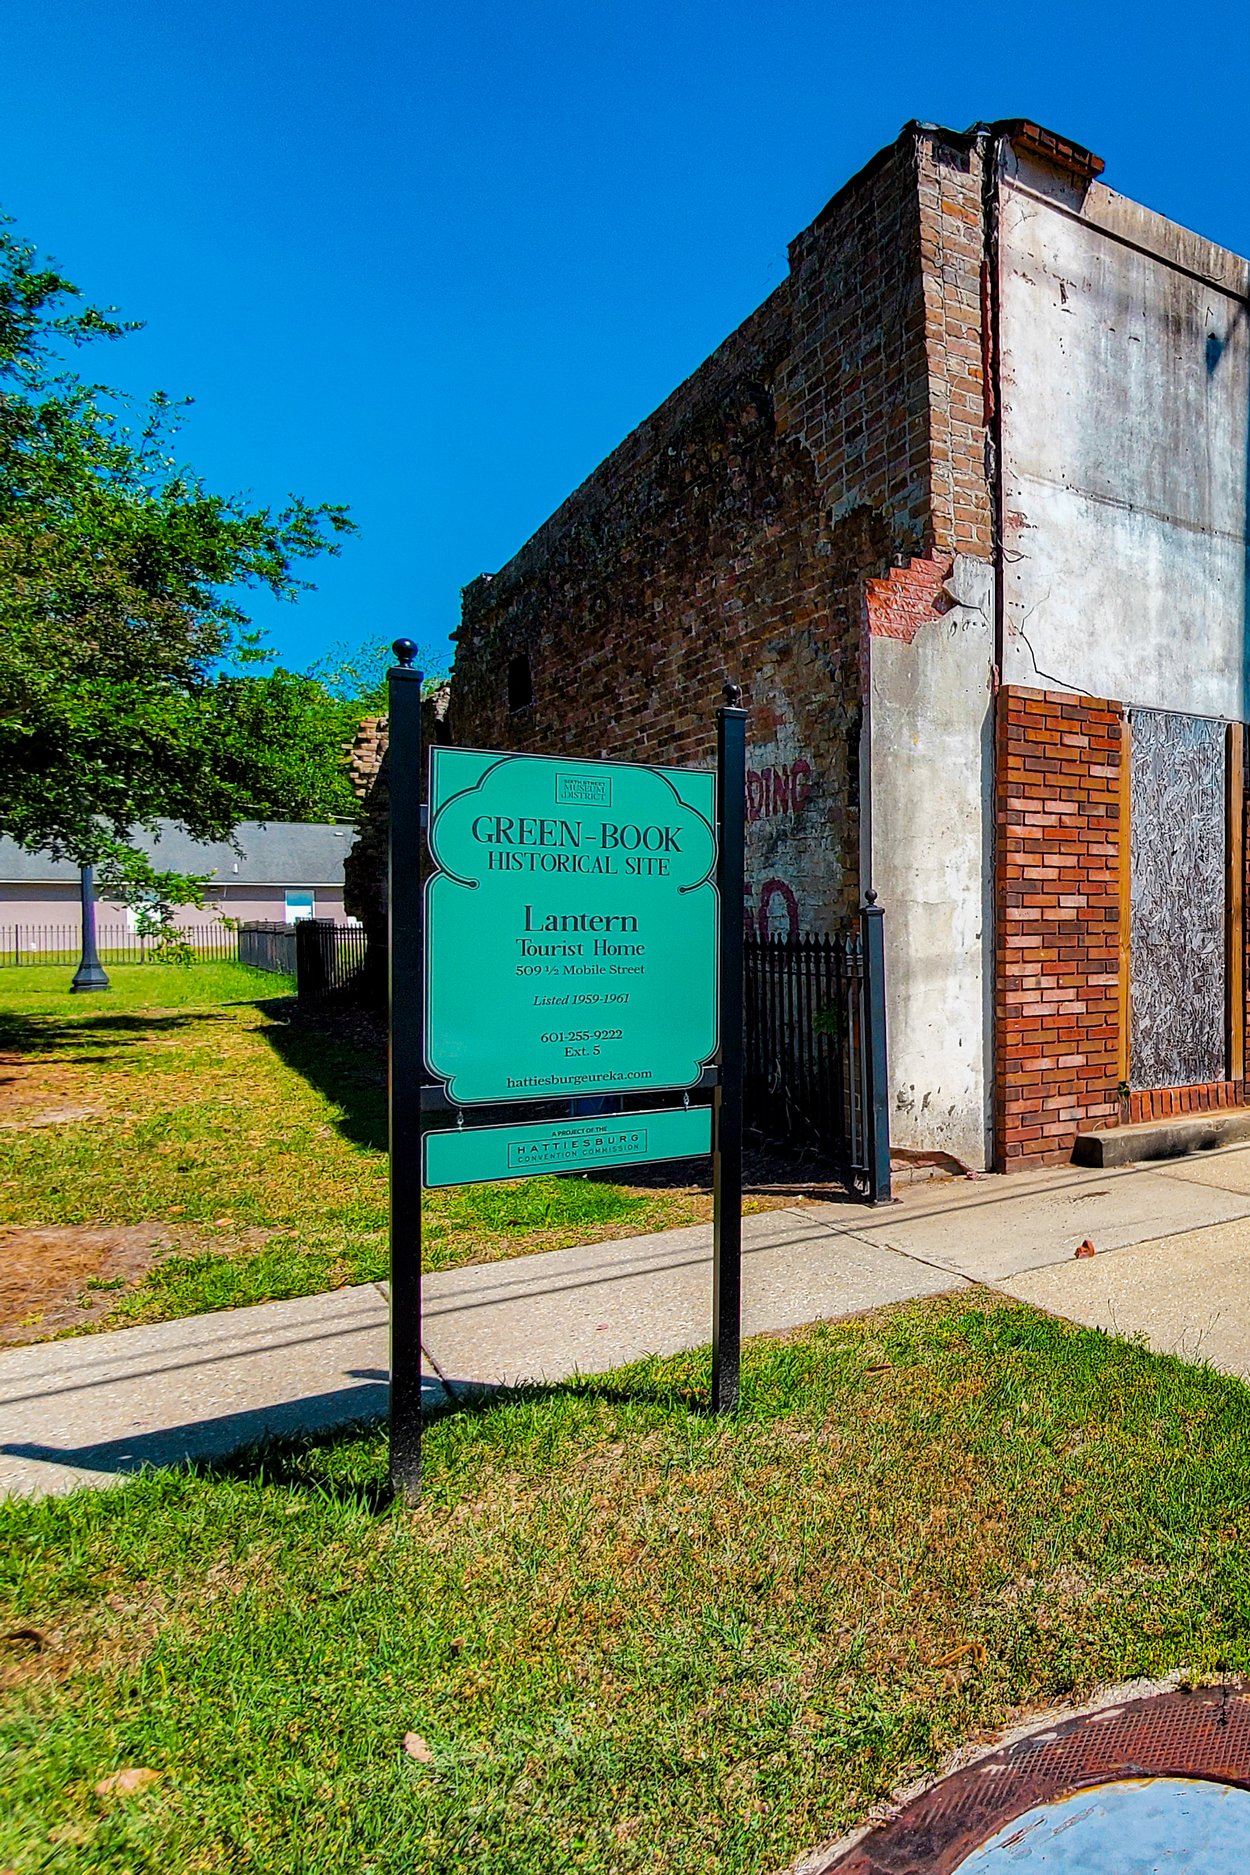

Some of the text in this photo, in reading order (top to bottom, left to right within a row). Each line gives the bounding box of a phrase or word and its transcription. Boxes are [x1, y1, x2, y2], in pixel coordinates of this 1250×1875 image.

[563, 784, 605, 794] MUSEUM
[472, 815, 684, 853] GREEN-BOOK
[488, 850, 670, 876] HISTORICAL SITE
[523, 904, 639, 933] Lantern
[515, 938, 646, 957] Tourist Home
[515, 964, 543, 976] 509
[562, 964, 606, 976] Mobile
[609, 963, 645, 975] Street
[532, 993, 630, 1007] Listed 1959-1961
[540, 1028, 623, 1043] 601-255-9222
[564, 1045, 601, 1058] Ext. 5
[506, 1070, 652, 1089] hattiesburgeureka.com
[558, 1128, 584, 1136] PROJECT
[517, 1134, 639, 1154] HATTIESBURG
[517, 1143, 639, 1163] CONVENTION COMMISSION
